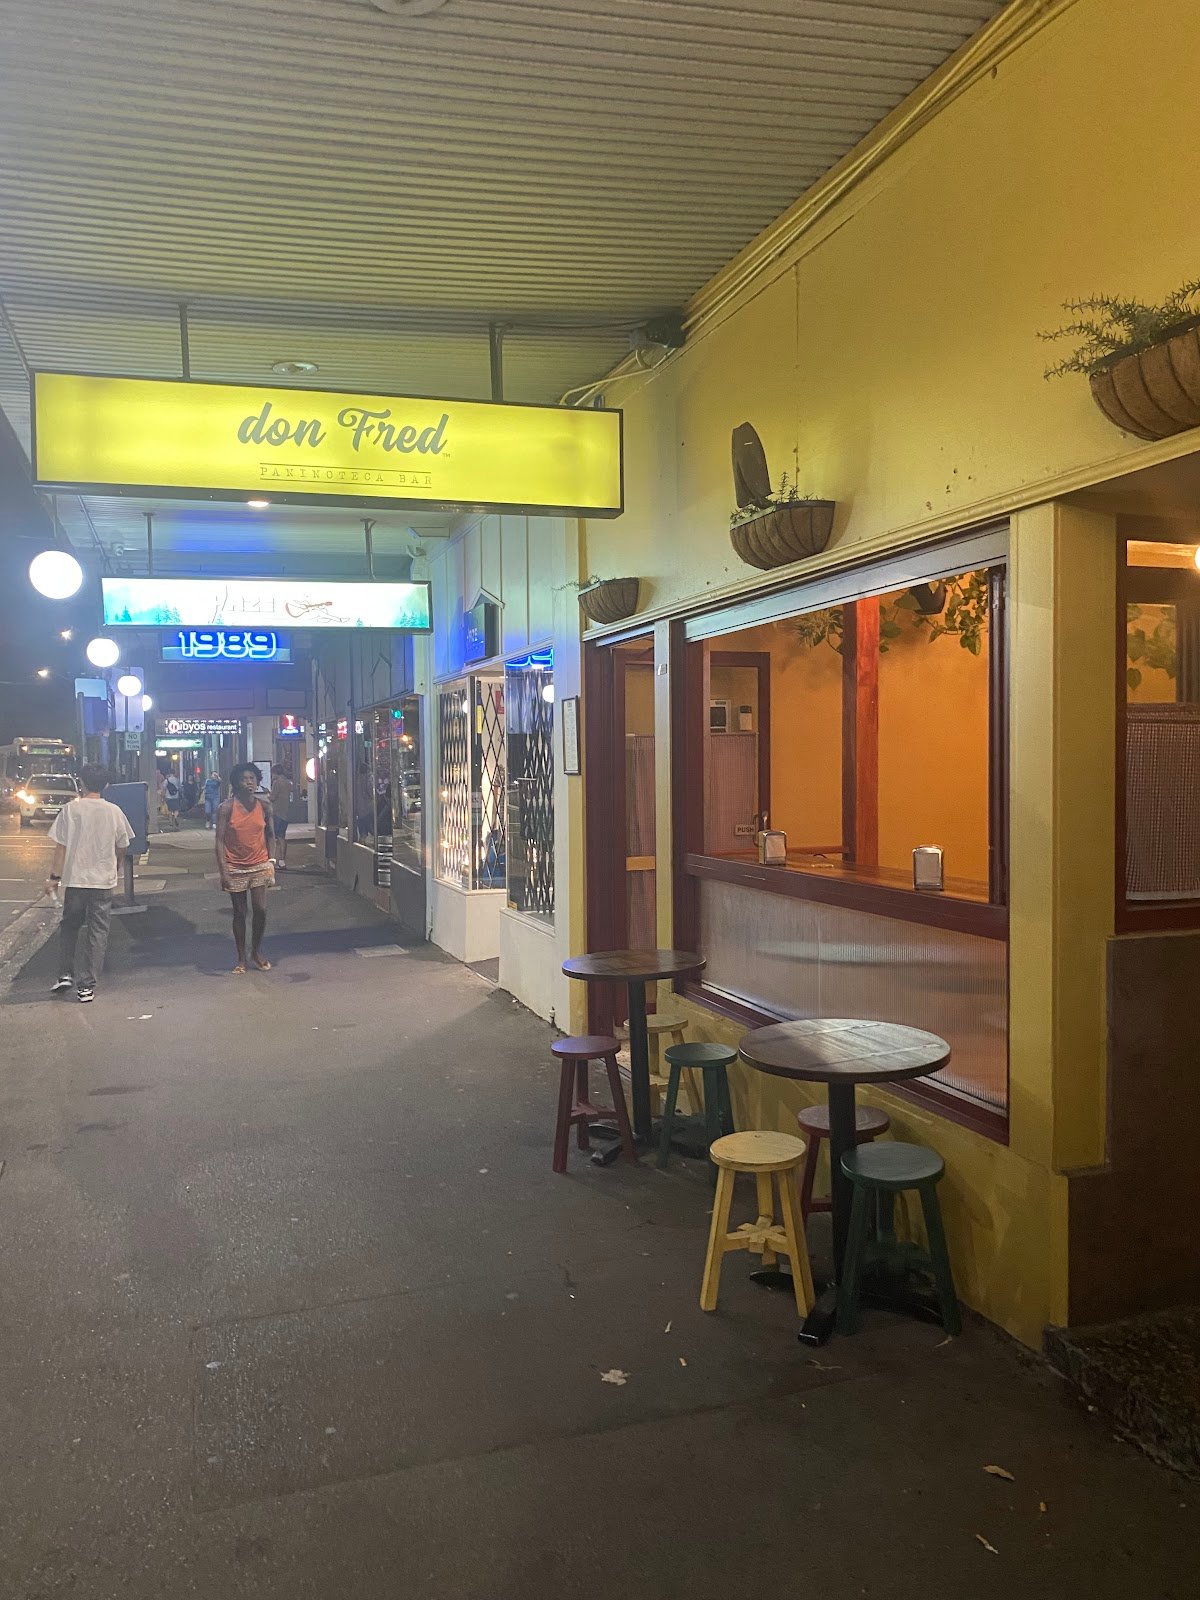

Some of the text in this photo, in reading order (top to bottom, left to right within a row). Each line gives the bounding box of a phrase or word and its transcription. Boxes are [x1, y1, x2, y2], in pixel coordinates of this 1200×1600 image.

[238, 402, 327, 447] don
[337, 408, 449, 454] Fred
[260, 467, 432, 484] PANINOTECA BAR
[179, 631, 276, 658] 1989
